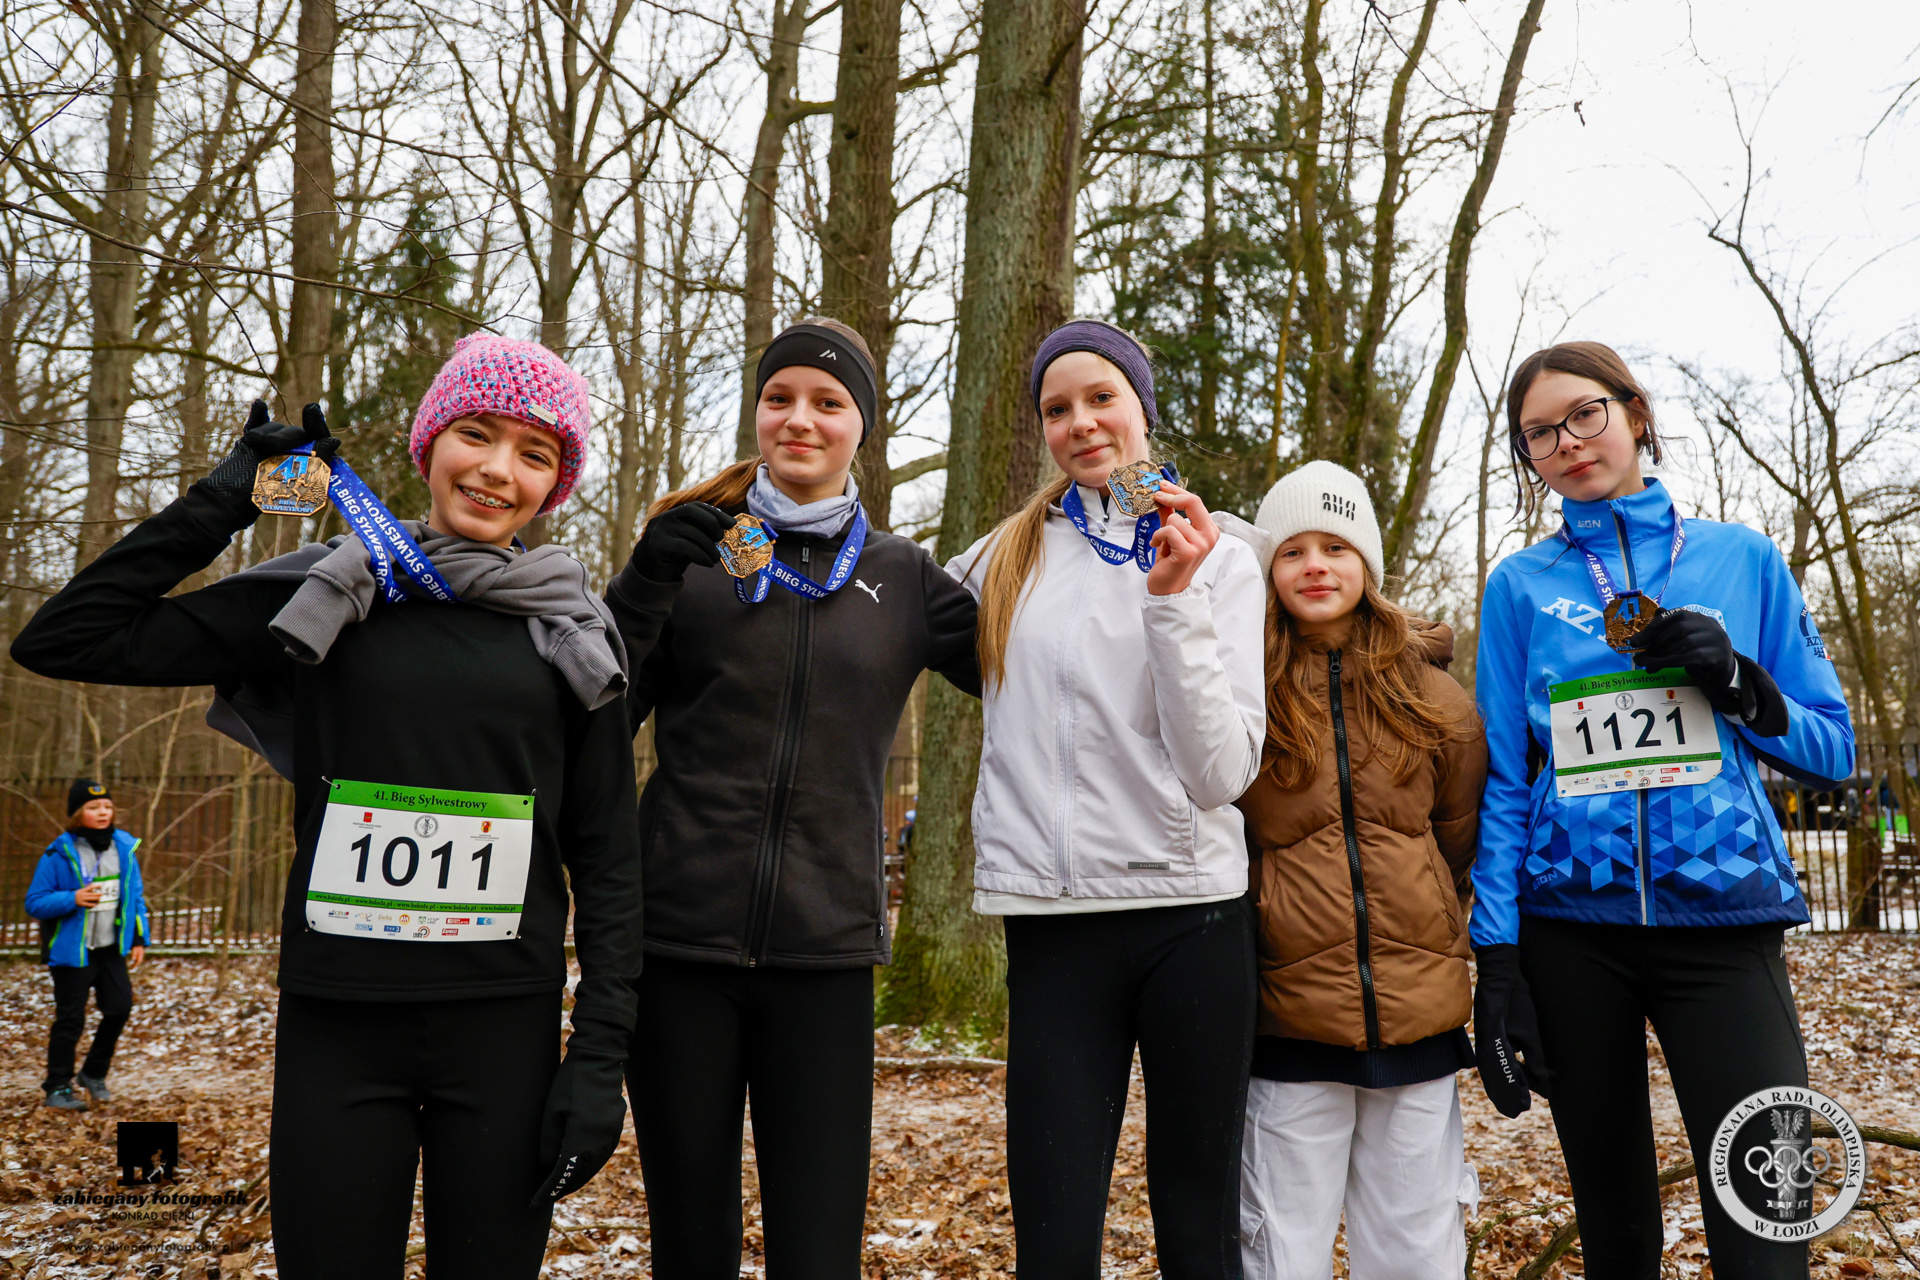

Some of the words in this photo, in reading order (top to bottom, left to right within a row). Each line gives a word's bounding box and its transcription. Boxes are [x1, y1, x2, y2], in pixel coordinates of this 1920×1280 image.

[329, 474, 361, 515] 41.BIEG
[836, 545, 856, 579] 41.BIEG
[1135, 519, 1151, 564] 41.BIEG
[1579, 682, 1590, 692] 41.
[1591, 680, 1612, 690] Bieg
[1613, 674, 1667, 687] Sylwestrowy
[1575, 706, 1686, 756] 1121
[373, 791, 389, 801] 41.
[391, 791, 416, 806] Bieg
[418, 793, 488, 812] Sylwestrowy
[351, 833, 493, 891] 1011
[1494, 1038, 1515, 1084] KIPRUN
[550, 1155, 578, 1197] KIPSTA
